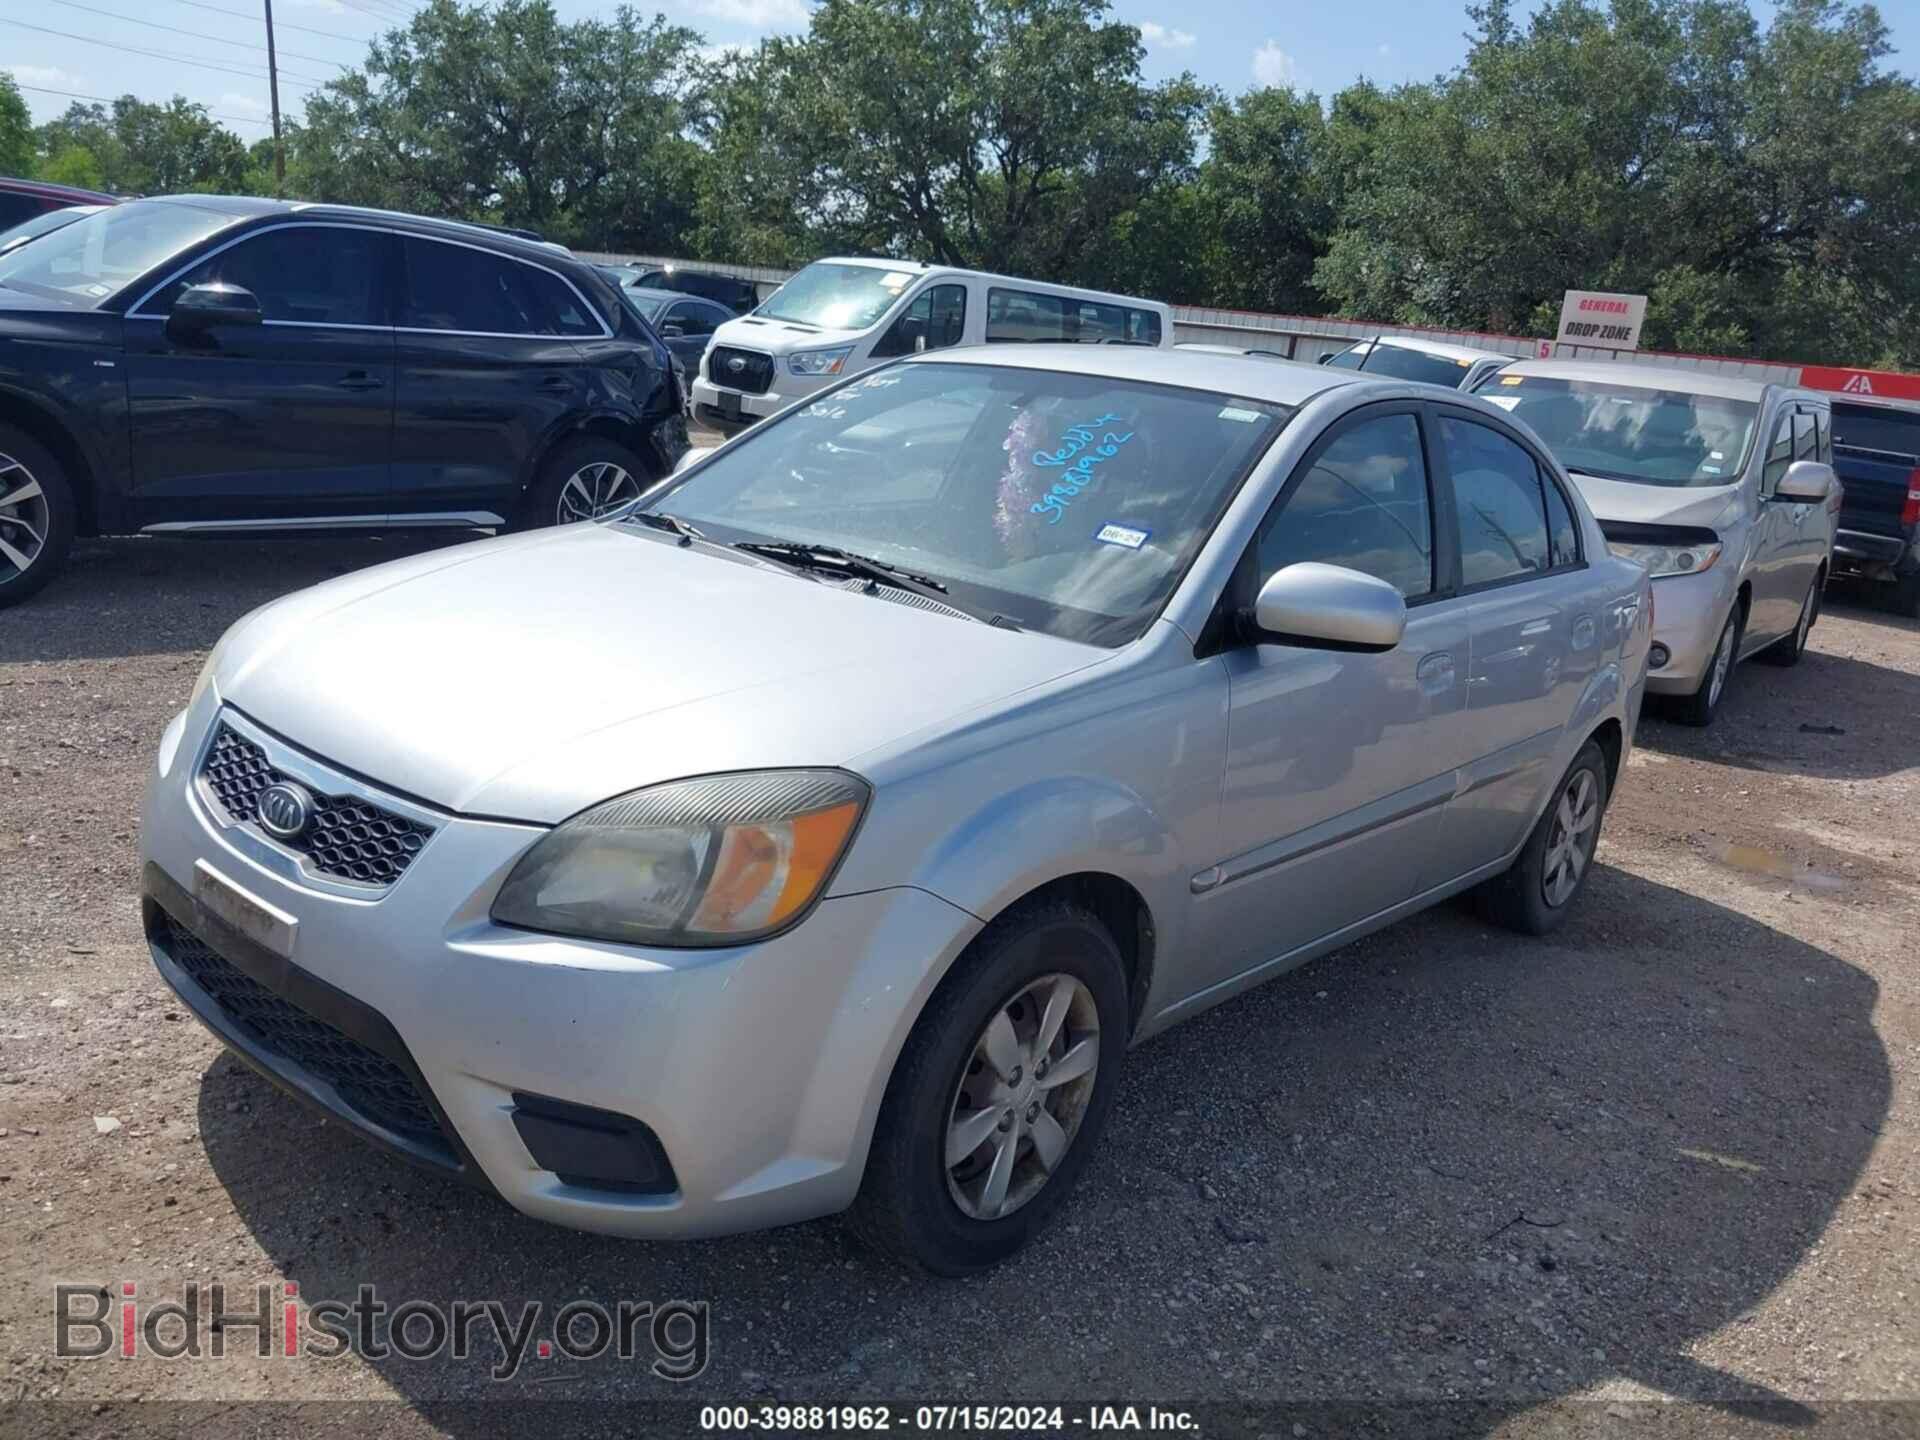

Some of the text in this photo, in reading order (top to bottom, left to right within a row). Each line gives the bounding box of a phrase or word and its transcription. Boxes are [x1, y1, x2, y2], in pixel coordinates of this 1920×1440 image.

[1580, 299, 1629, 314] GENERAL
[1565, 322, 1632, 340] DROP ZONE
[1540, 343, 1550, 358] 5
